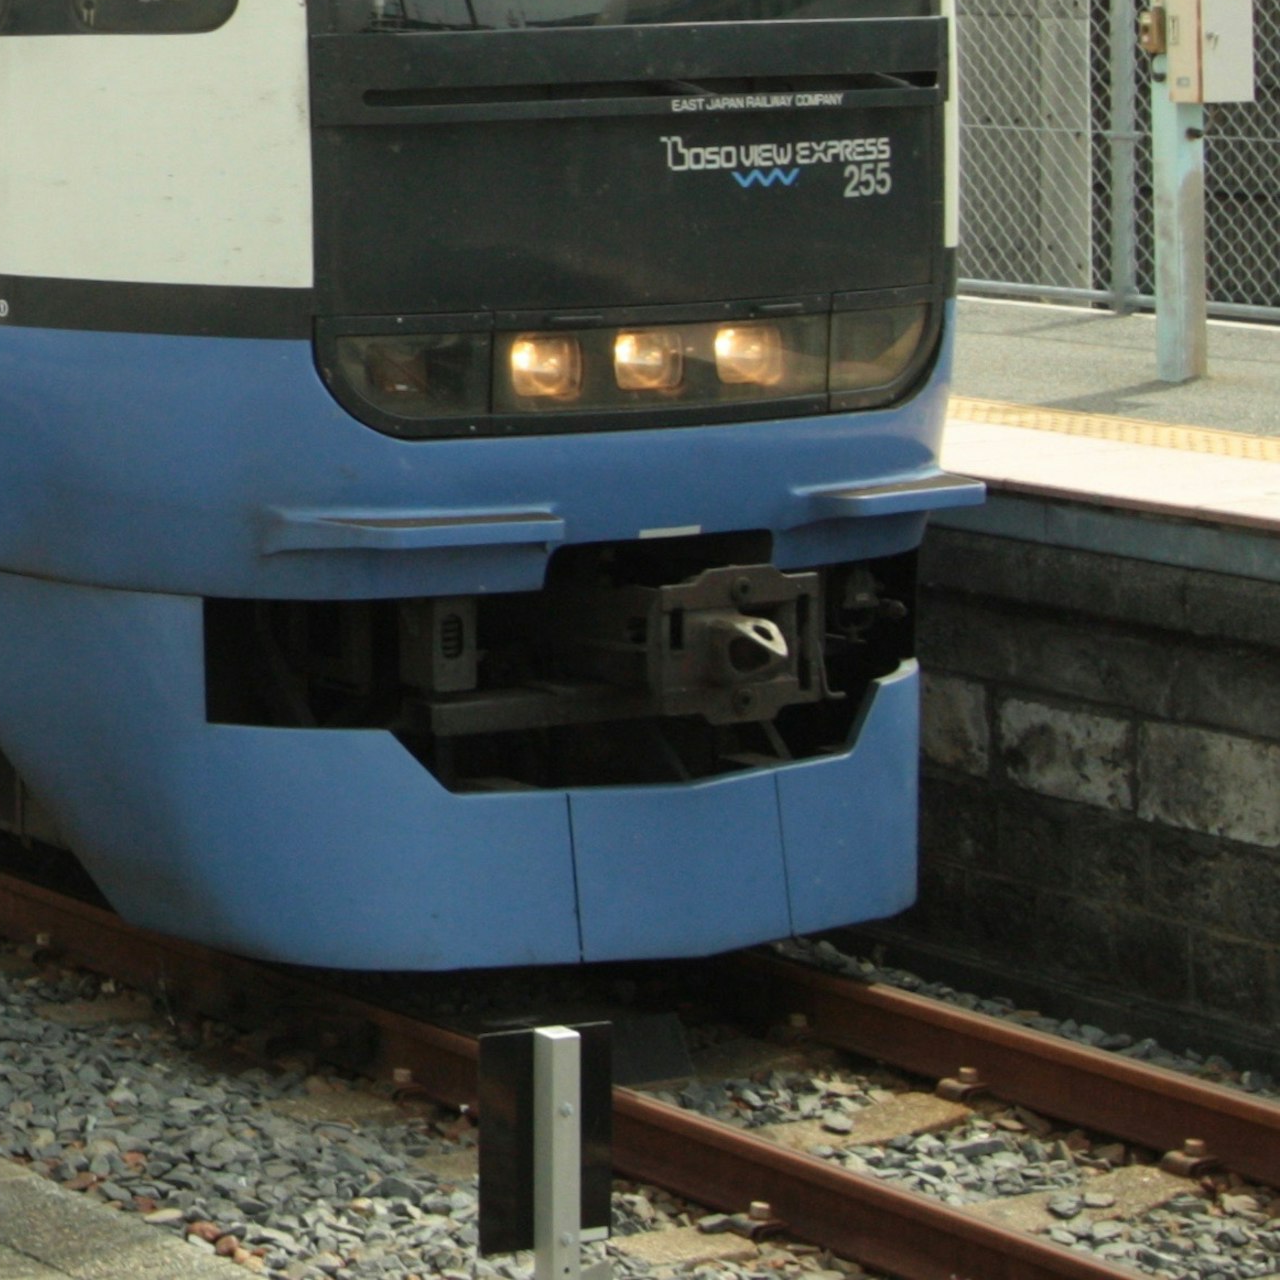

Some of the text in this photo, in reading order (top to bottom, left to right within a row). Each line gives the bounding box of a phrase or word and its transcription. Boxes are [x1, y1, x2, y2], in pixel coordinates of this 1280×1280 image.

[671, 92, 844, 112] EAST JAPAN RAILWAY COMPANY
[740, 143, 792, 167] VIEW
[795, 137, 891, 164] EXPRESS
[843, 162, 892, 198] 255
